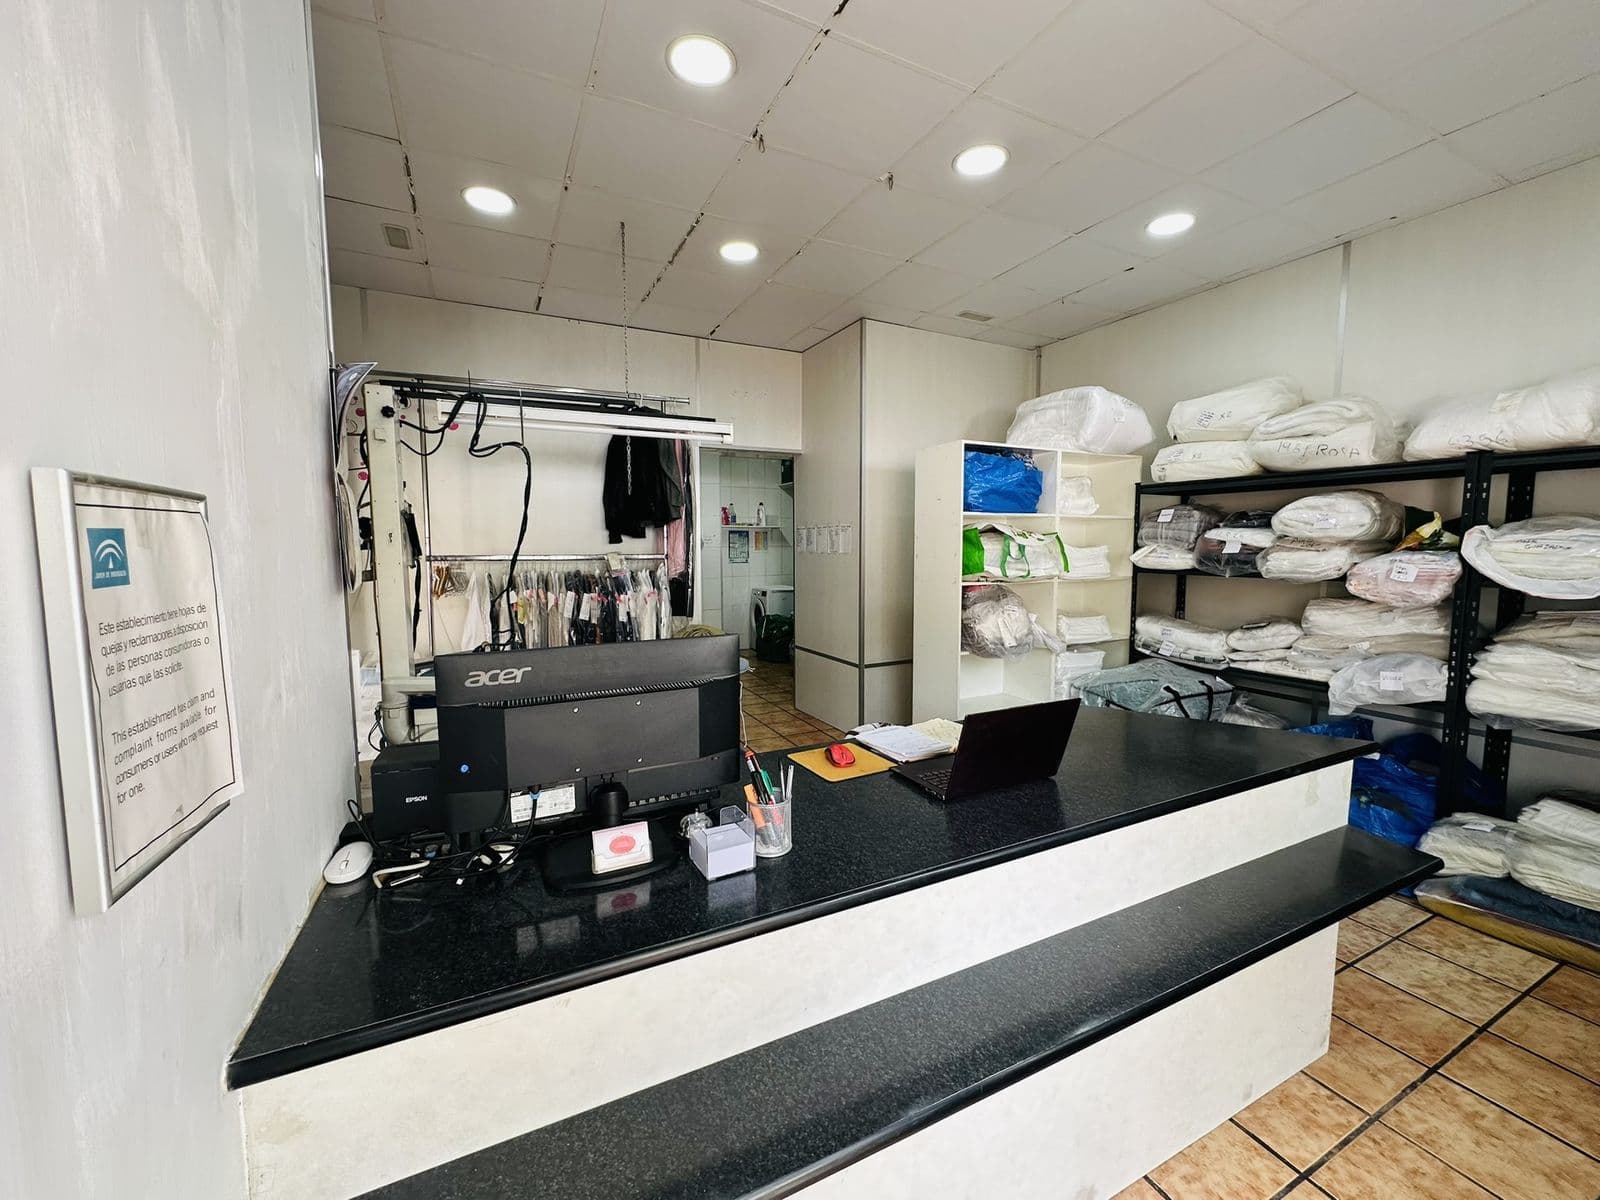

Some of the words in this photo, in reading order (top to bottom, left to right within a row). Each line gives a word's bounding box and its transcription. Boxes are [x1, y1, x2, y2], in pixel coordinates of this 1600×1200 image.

[98, 622, 115, 636] Este
[196, 603, 207, 614] de
[105, 664, 115, 677] de
[116, 661, 126, 673] las
[127, 650, 163, 671] personas
[204, 636, 210, 645] o
[137, 672, 152, 687] que
[153, 668, 164, 680] las
[464, 666, 533, 688] acer
[111, 730, 127, 745] This
[127, 707, 177, 737] establishment
[200, 688, 215, 702] and
[114, 737, 153, 766] complaint
[156, 725, 178, 743] forms
[204, 705, 217, 716] for
[115, 756, 154, 785] consumers
[161, 744, 179, 760] users
[117, 790, 127, 805] for
[405, 795, 428, 803] EPSON
